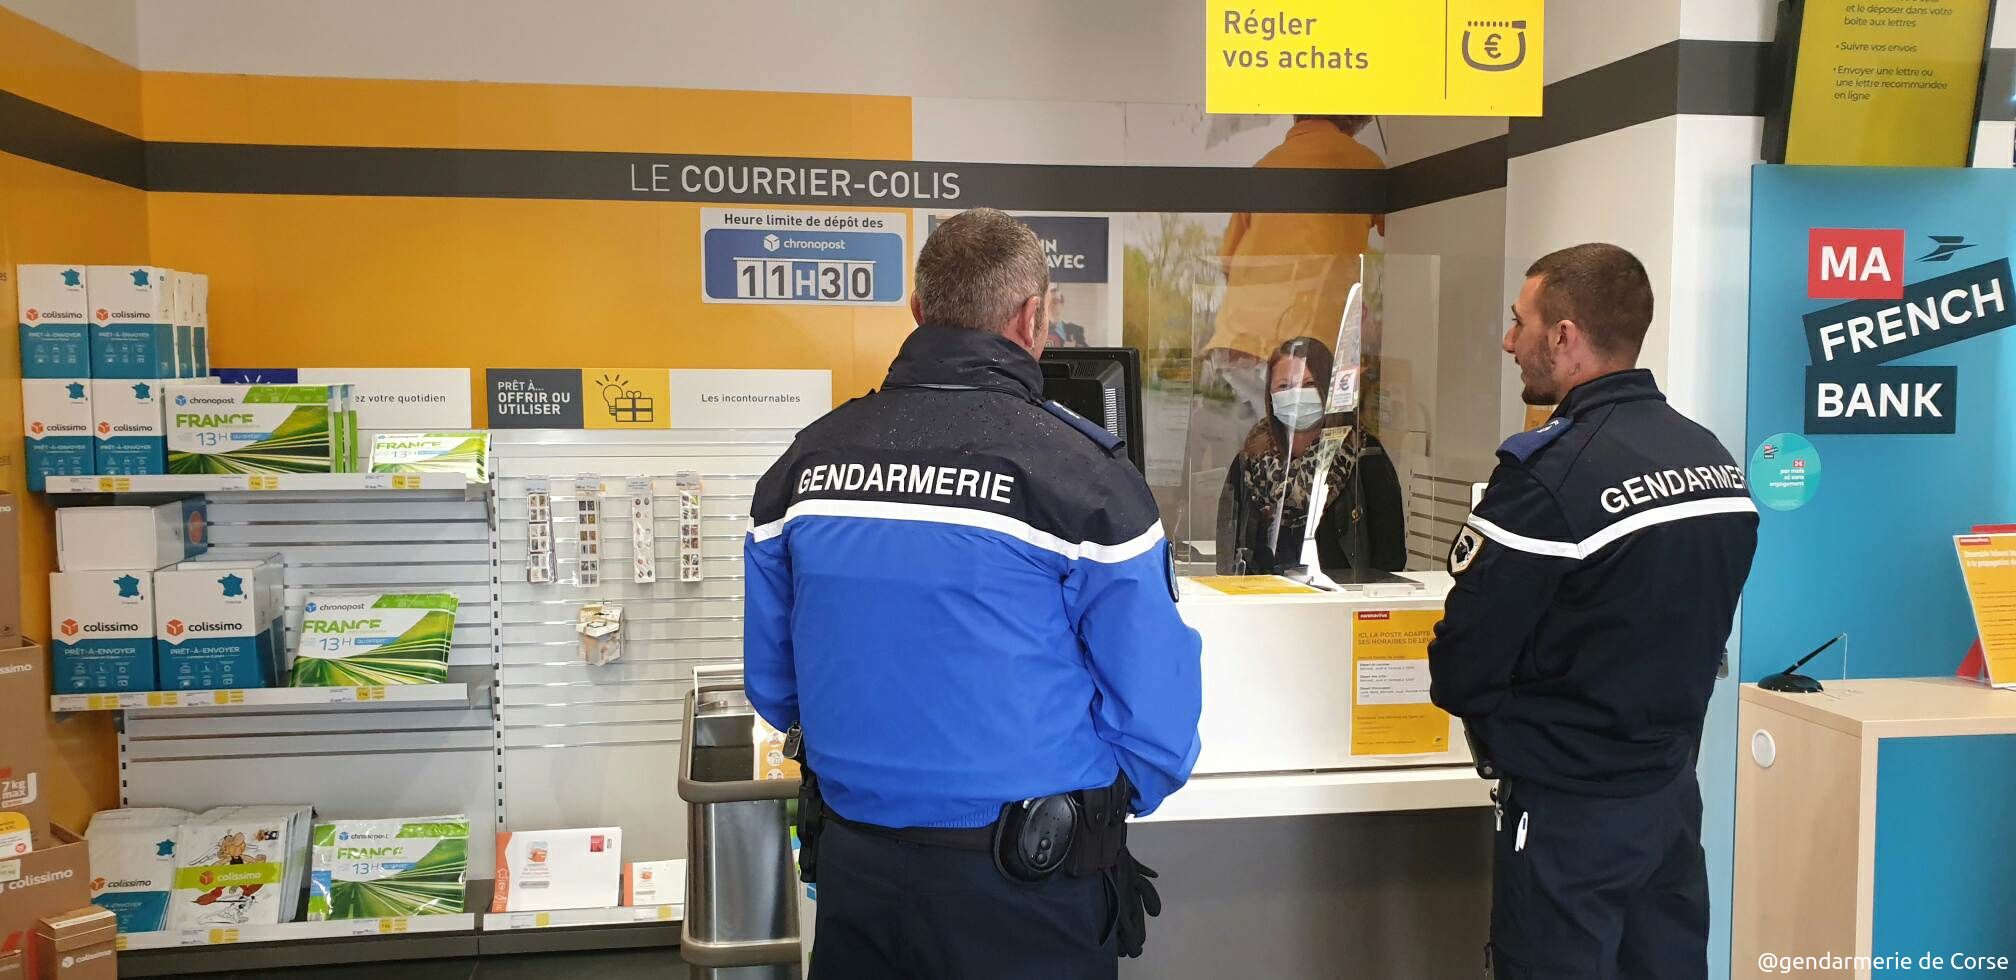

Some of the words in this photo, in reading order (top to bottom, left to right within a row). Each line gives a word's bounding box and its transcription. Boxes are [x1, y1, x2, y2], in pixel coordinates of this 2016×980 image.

[1224, 9, 1318, 41] Régler
[1888, 18, 1916, 27] lettres
[1841, 42, 1869, 51] Suivre
[1224, 49, 1269, 69] vos
[1278, 46, 1369, 70] achats
[1838, 66, 1874, 76] Envoyer
[1896, 67, 1918, 76] lettre
[1856, 80, 1881, 88] lettre
[1848, 90, 1870, 101] ligne
[630, 164, 670, 192] LE
[680, 164, 961, 200] COURRIER-COLIS
[724, 214, 763, 225] Heure
[767, 214, 802, 226] limite
[806, 216, 820, 227] de
[824, 216, 859, 229] dépôt
[862, 217, 883, 228] des
[784, 238, 846, 251] chronopost
[1047, 255, 1085, 269] AVEC
[1820, 246, 1891, 282] MA
[42, 311, 83, 319] colissimo
[111, 311, 151, 319] colissimo
[1820, 278, 2005, 362] FRENCH
[498, 380, 525, 391] PRÊT
[189, 397, 235, 406] chronopost
[398, 394, 446, 404] quotidien
[498, 392, 548, 403] OFFRIR
[552, 392, 570, 403] OU
[702, 394, 719, 403] Les
[722, 394, 800, 403] incontournables
[1817, 383, 1943, 418] BANK
[498, 404, 561, 415] UTILISER
[176, 414, 254, 428] FRANCE
[798, 463, 1015, 504] GENDARMERIE
[319, 603, 365, 612] chronopost
[83, 622, 139, 632] colissimo
[188, 620, 242, 632] colissimo
[302, 619, 382, 634] FRANCE
[337, 846, 404, 860] FRANCE
[8, 869, 73, 890] colissimo
[217, 871, 262, 881] colissimo
[107, 879, 151, 888] colissimo
